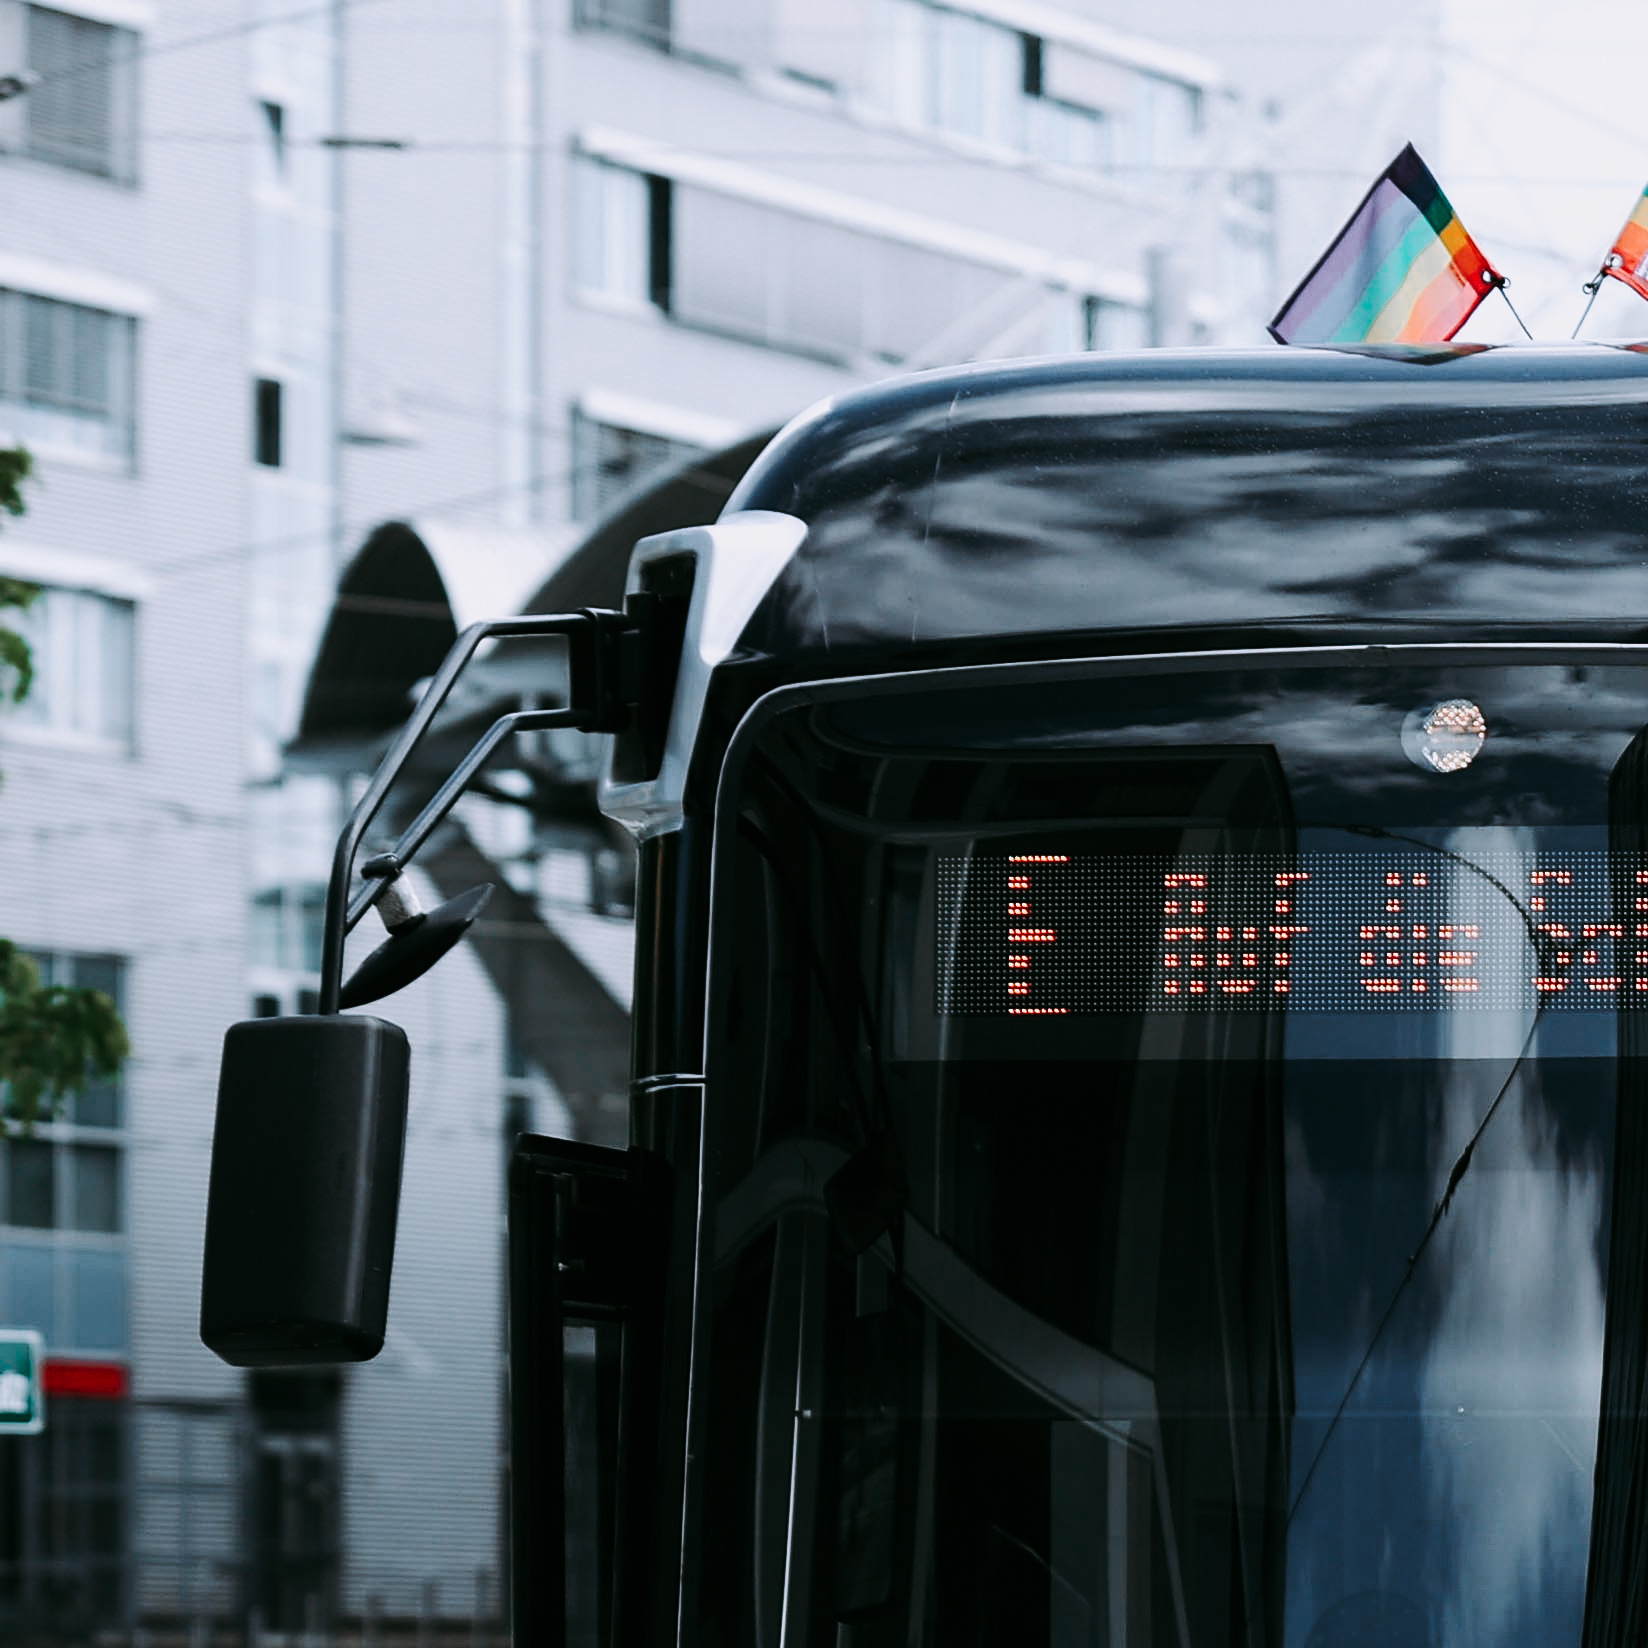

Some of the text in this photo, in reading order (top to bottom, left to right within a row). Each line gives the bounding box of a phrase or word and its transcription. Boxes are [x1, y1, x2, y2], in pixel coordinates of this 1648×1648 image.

[1008, 856, 1070, 1014] E
[1164, 873, 1310, 993] Auf
[1359, 872, 1481, 993] die
